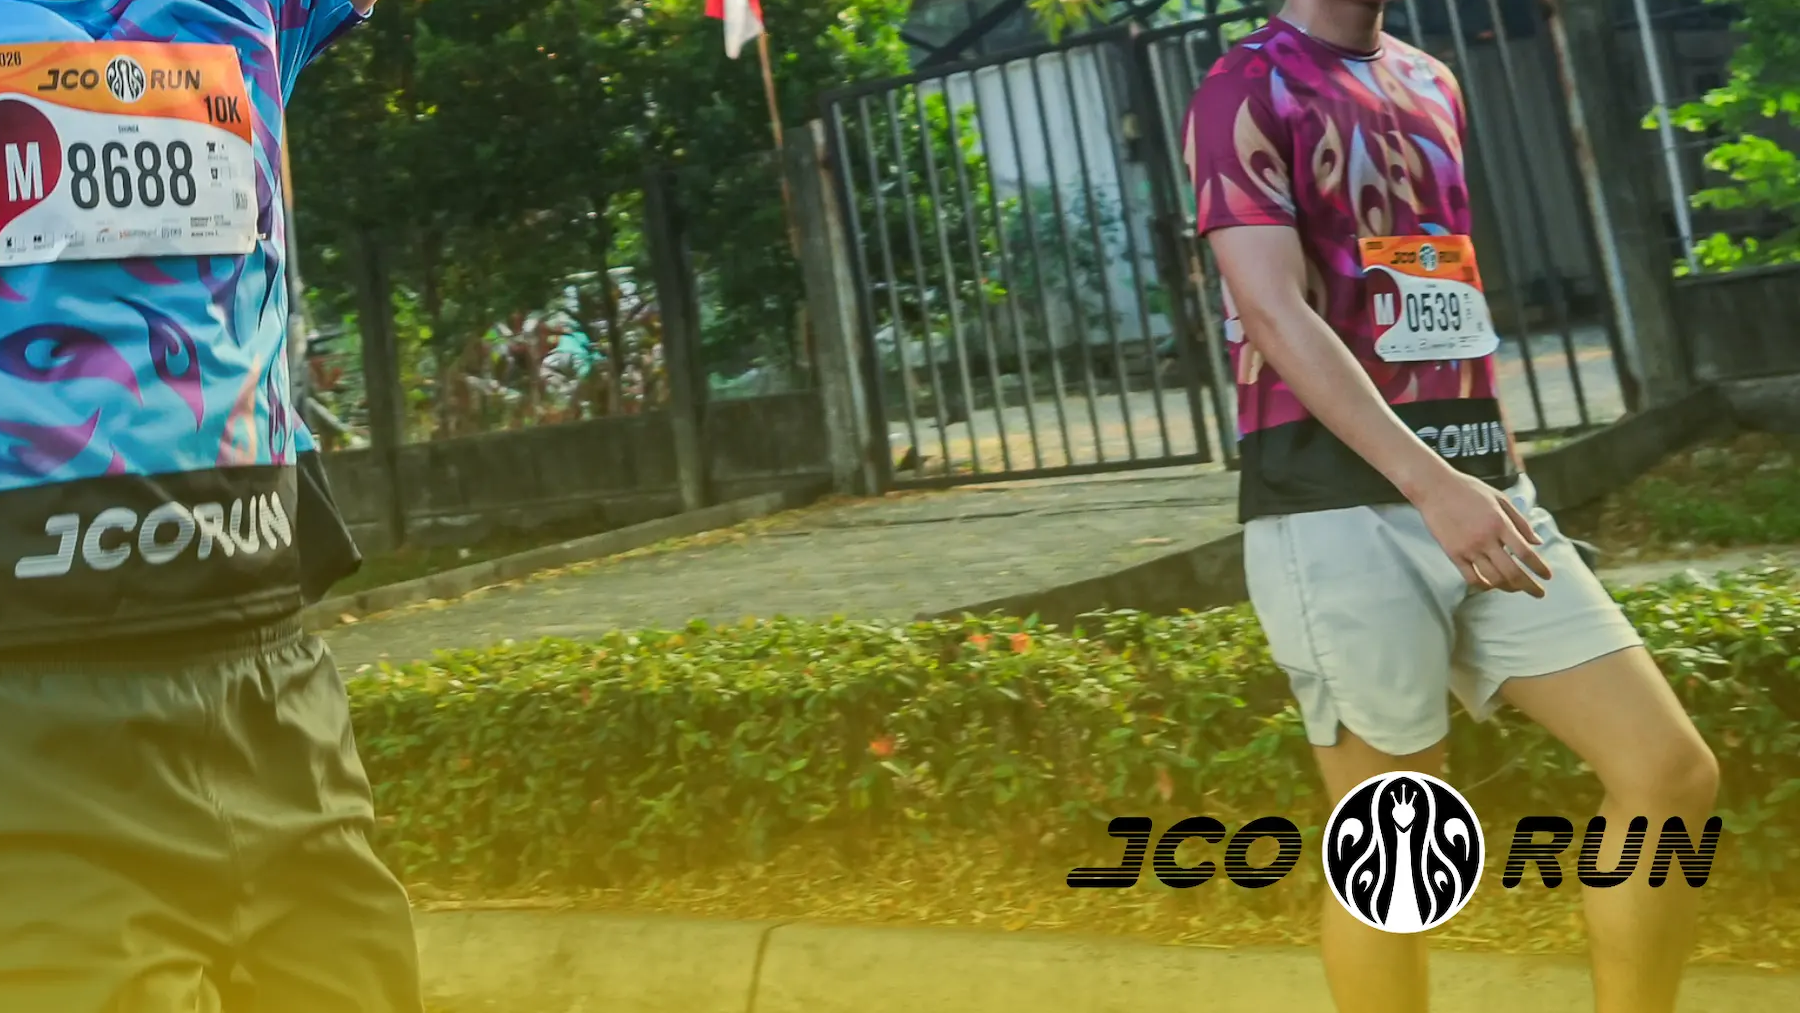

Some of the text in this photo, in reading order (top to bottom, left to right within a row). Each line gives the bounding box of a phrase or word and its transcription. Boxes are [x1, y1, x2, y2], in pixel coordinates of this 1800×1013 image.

[37, 69, 201, 91] JCO RUN
[204, 95, 242, 124] 10K
[4, 141, 44, 203] M
[67, 140, 197, 210] 8688
[1373, 293, 1395, 326] M
[1406, 292, 1462, 332] 0539
[14, 491, 292, 579] JCORUN
